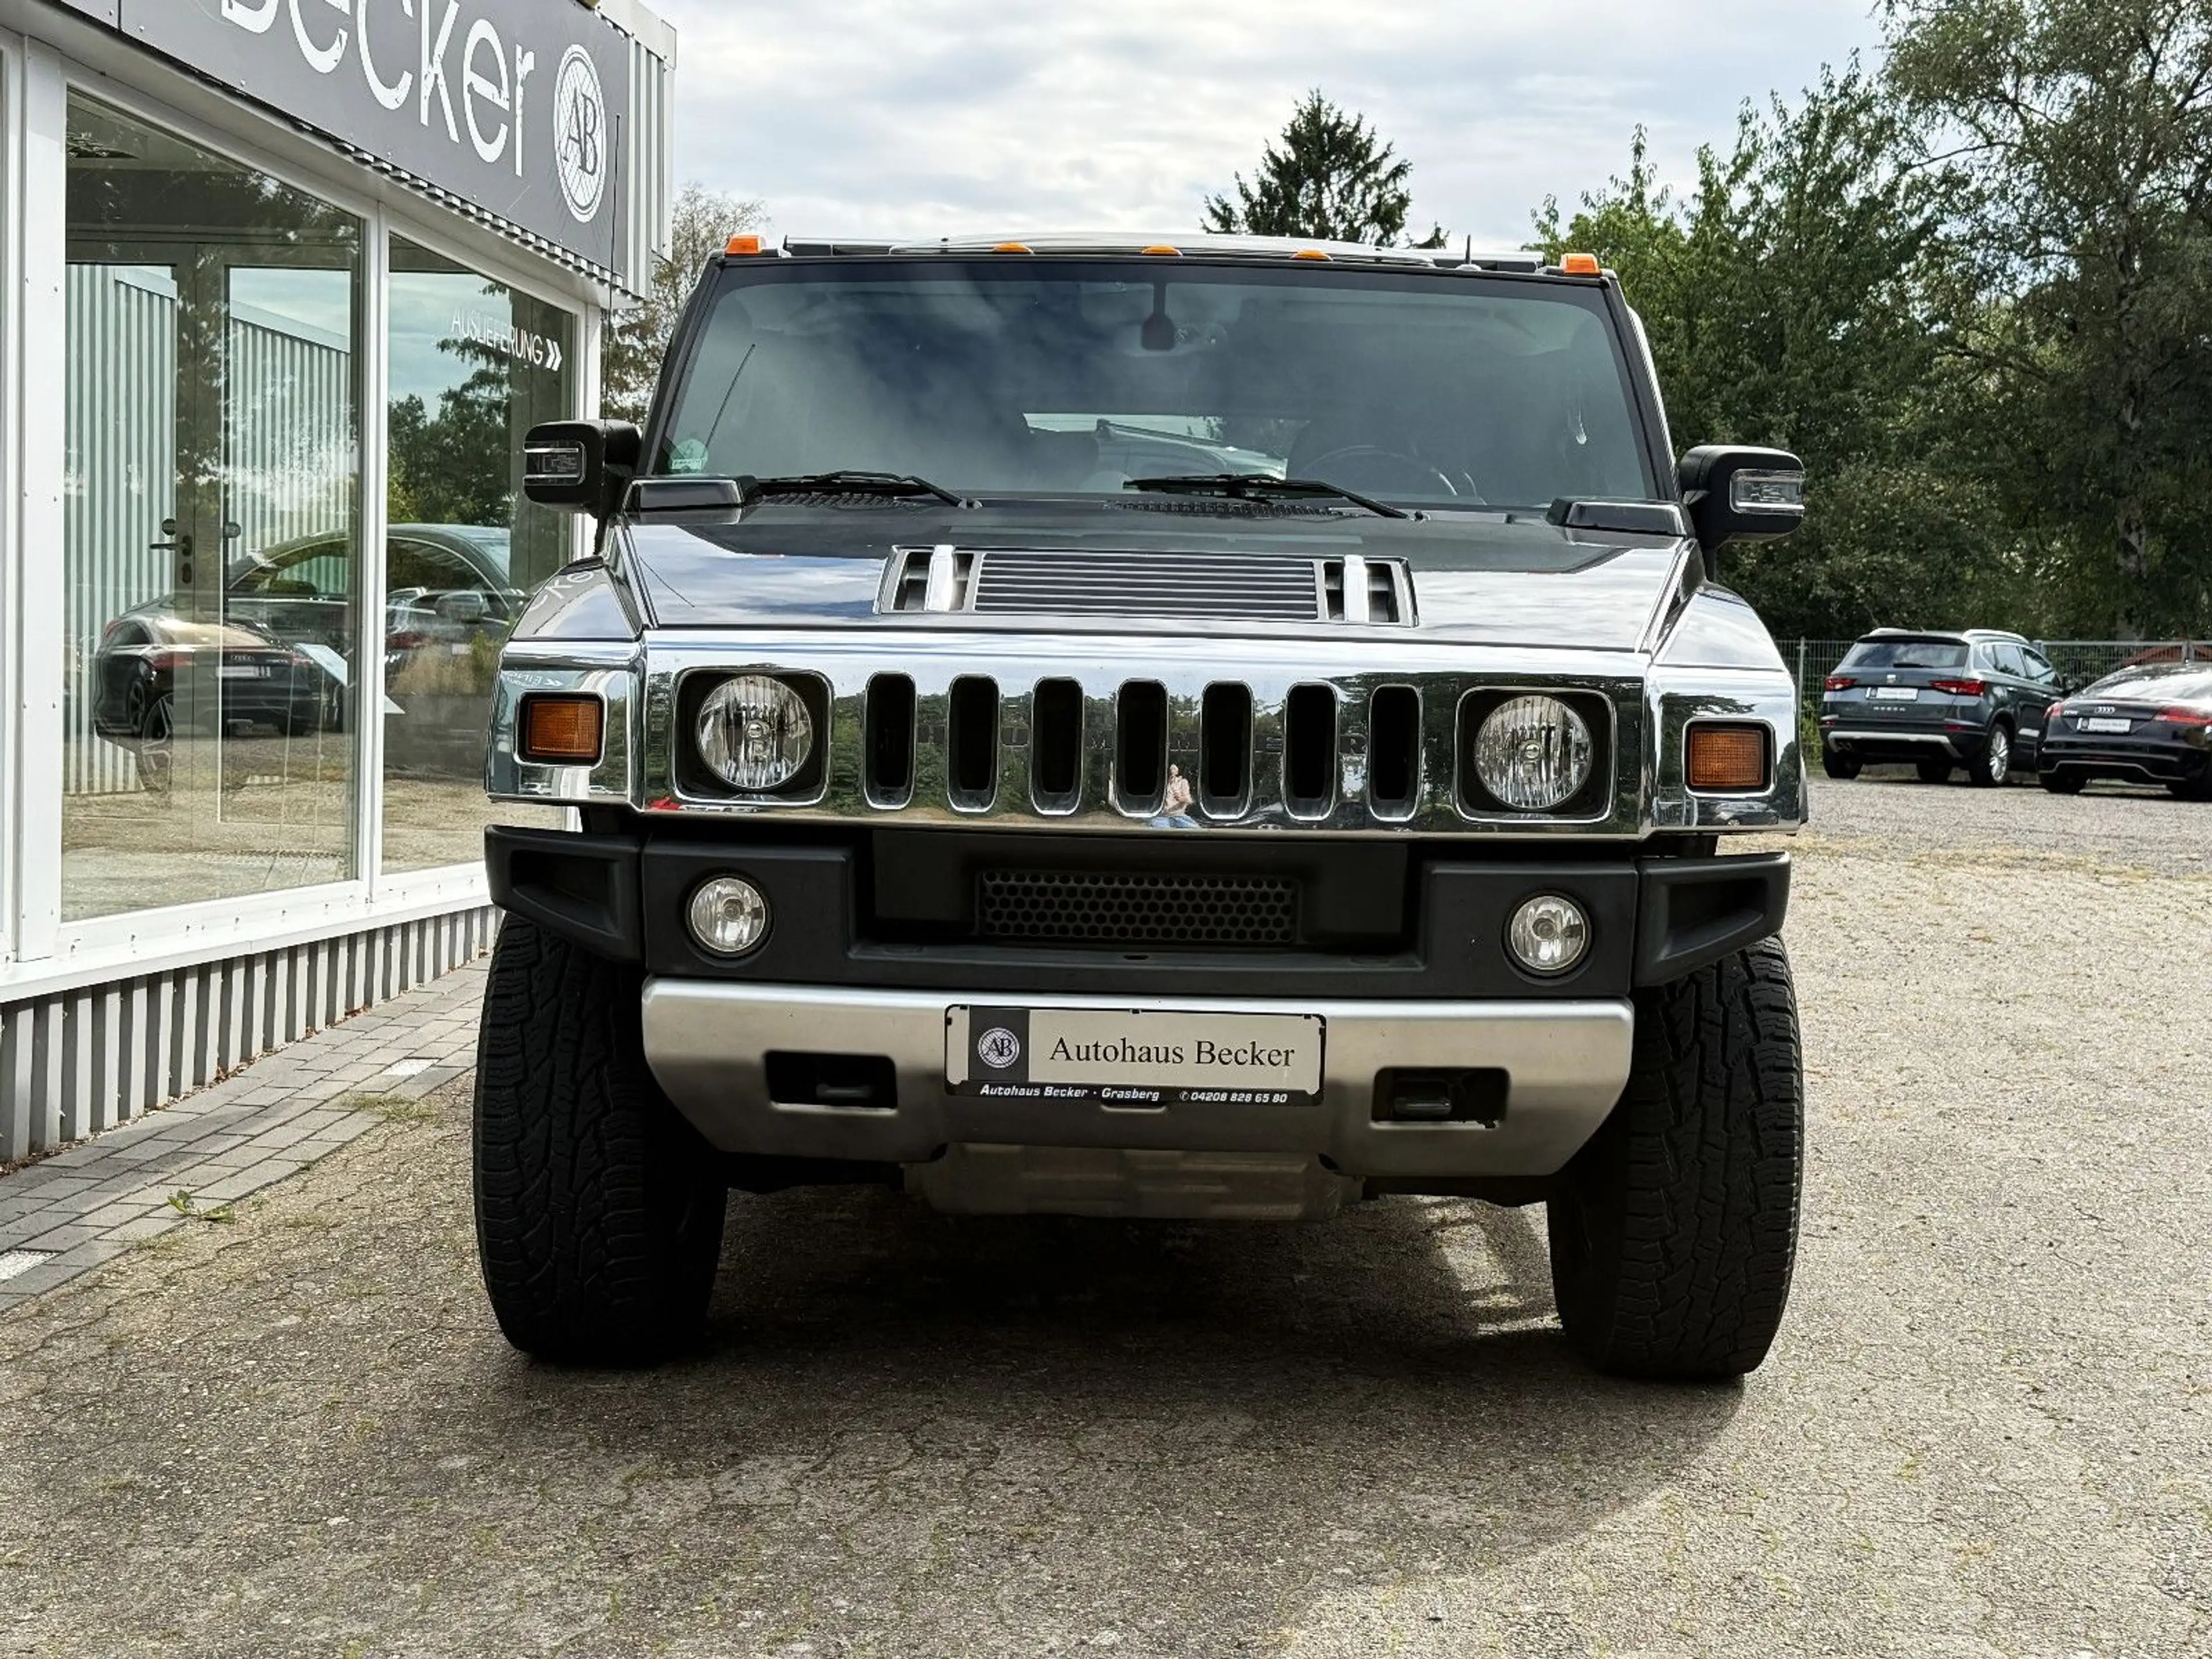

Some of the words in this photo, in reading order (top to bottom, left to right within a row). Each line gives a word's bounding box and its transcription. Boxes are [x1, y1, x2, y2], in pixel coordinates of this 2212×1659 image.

[221, 0, 535, 177] cker
[452, 307, 543, 365] AUSLIEFERUNG
[1049, 1037, 1184, 1064] Autohaus
[1194, 1040, 1296, 1067] Becker
[980, 1084, 1040, 1096] Autohaus
[1043, 1086, 1088, 1098] Becker
[1101, 1088, 1160, 1101] Grasberg
[1190, 1092, 1228, 1101] 04208
[1230, 1093, 1252, 1103] 828
[1255, 1093, 1270, 1103] 65
[1272, 1093, 1288, 1103] 80
